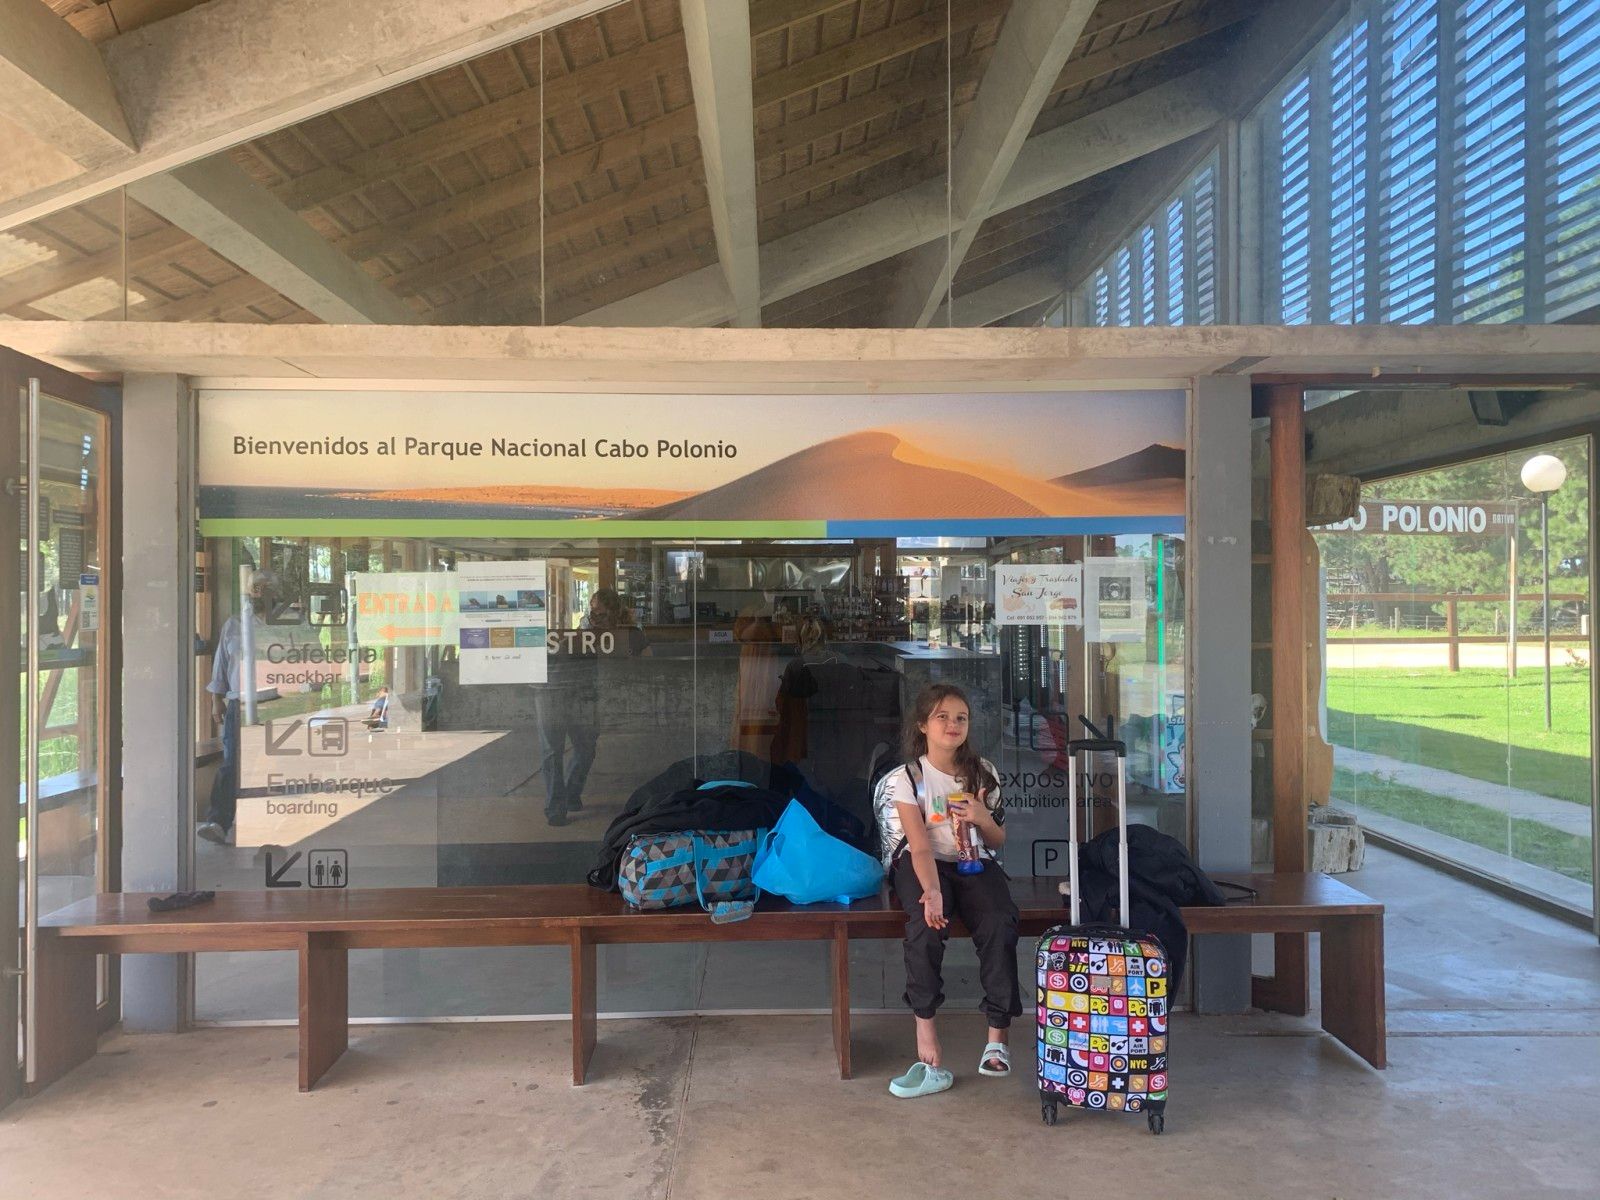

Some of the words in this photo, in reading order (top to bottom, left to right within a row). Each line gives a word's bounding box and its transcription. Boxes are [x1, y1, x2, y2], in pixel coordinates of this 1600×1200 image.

[233, 436, 369, 455] Bienvenidos
[376, 436, 396, 455] al
[404, 437, 483, 460] Parque
[491, 438, 587, 457] Nacional
[594, 439, 649, 458] Cabo
[657, 440, 738, 458] Polonio
[1382, 505, 1487, 533] POLONIO
[358, 591, 455, 615] ENTRADA
[1011, 588, 1034, 599] San
[1035, 587, 1063, 600] Jorge
[547, 631, 615, 655] STRO
[266, 670, 342, 685] snackbar
[267, 773, 393, 798] Embarque
[999, 772, 1114, 793] exposivo
[266, 800, 338, 817] boarding
[1002, 794, 1069, 808] xhibition
[1071, 940, 1088, 948] NYC
[1130, 1059, 1148, 1069] NYC
